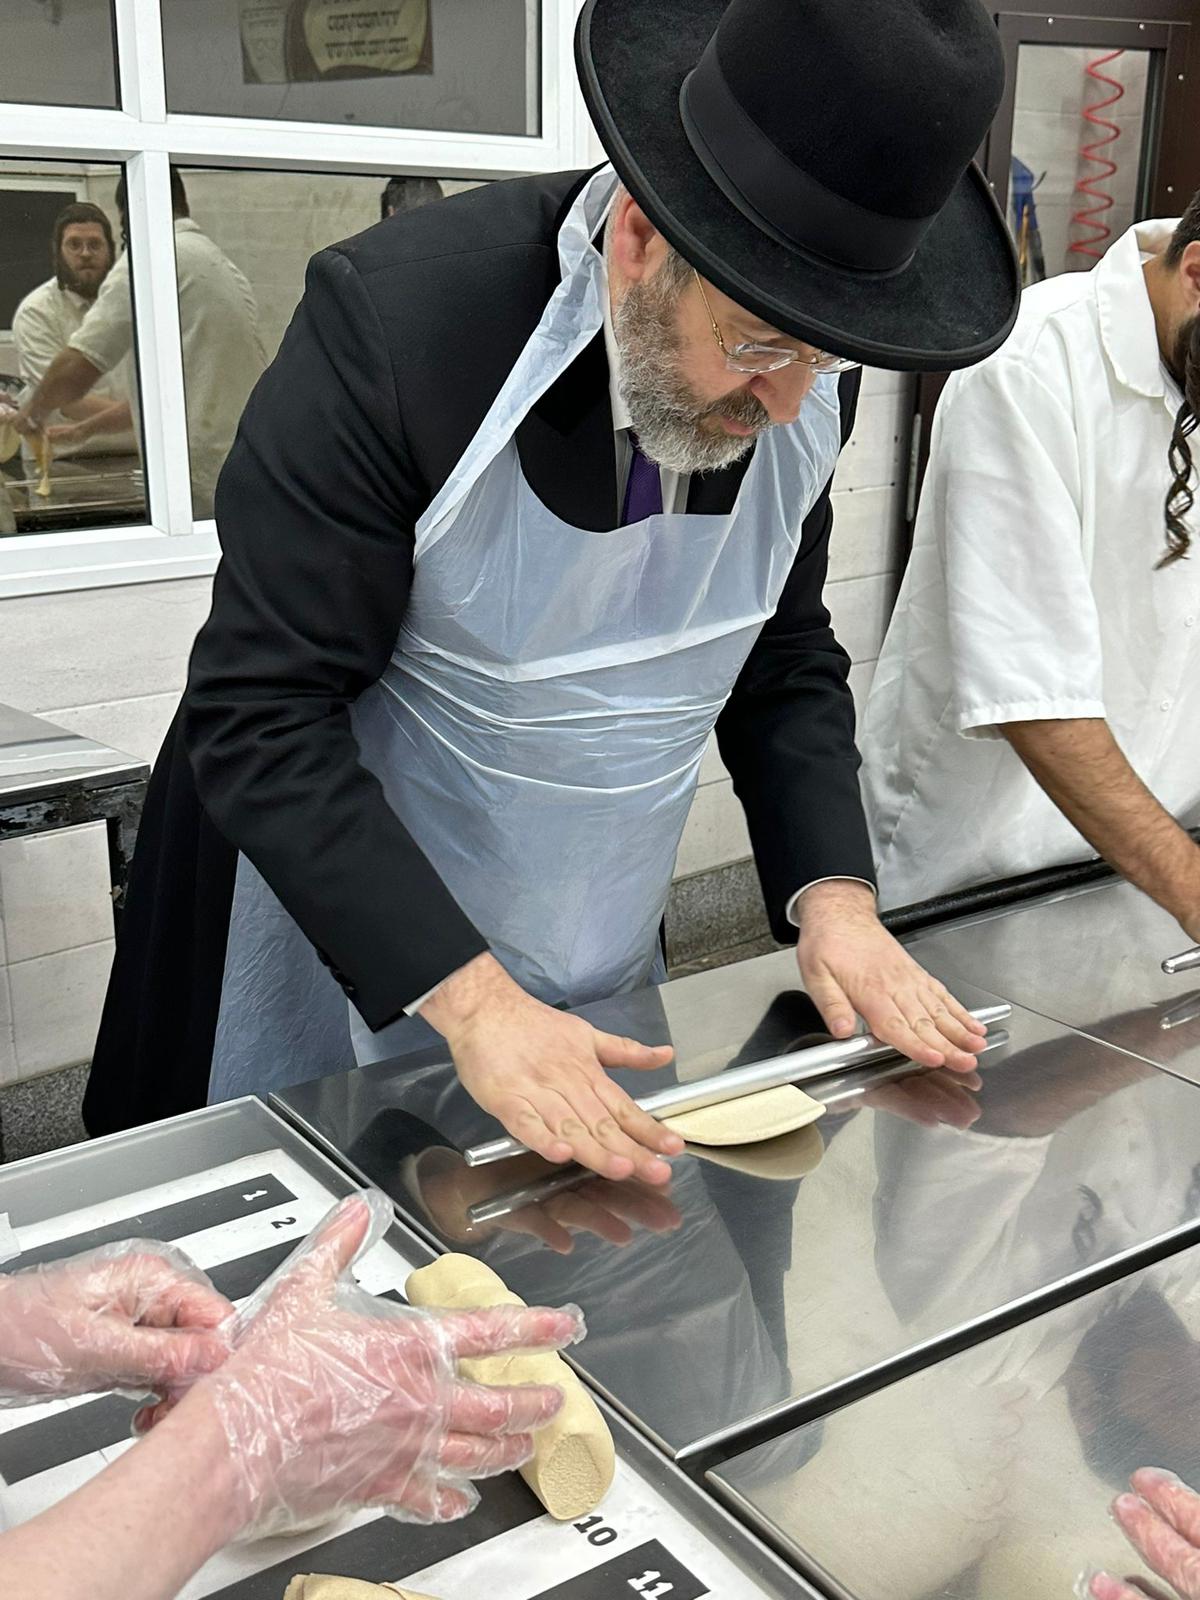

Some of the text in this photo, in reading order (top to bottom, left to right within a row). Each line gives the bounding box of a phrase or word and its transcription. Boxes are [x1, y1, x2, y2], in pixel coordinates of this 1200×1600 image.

[242, 1190, 268, 1201] 1
[271, 1216, 297, 1229] 2
[572, 1515, 618, 1546] 10
[627, 1570, 674, 1600] 11
